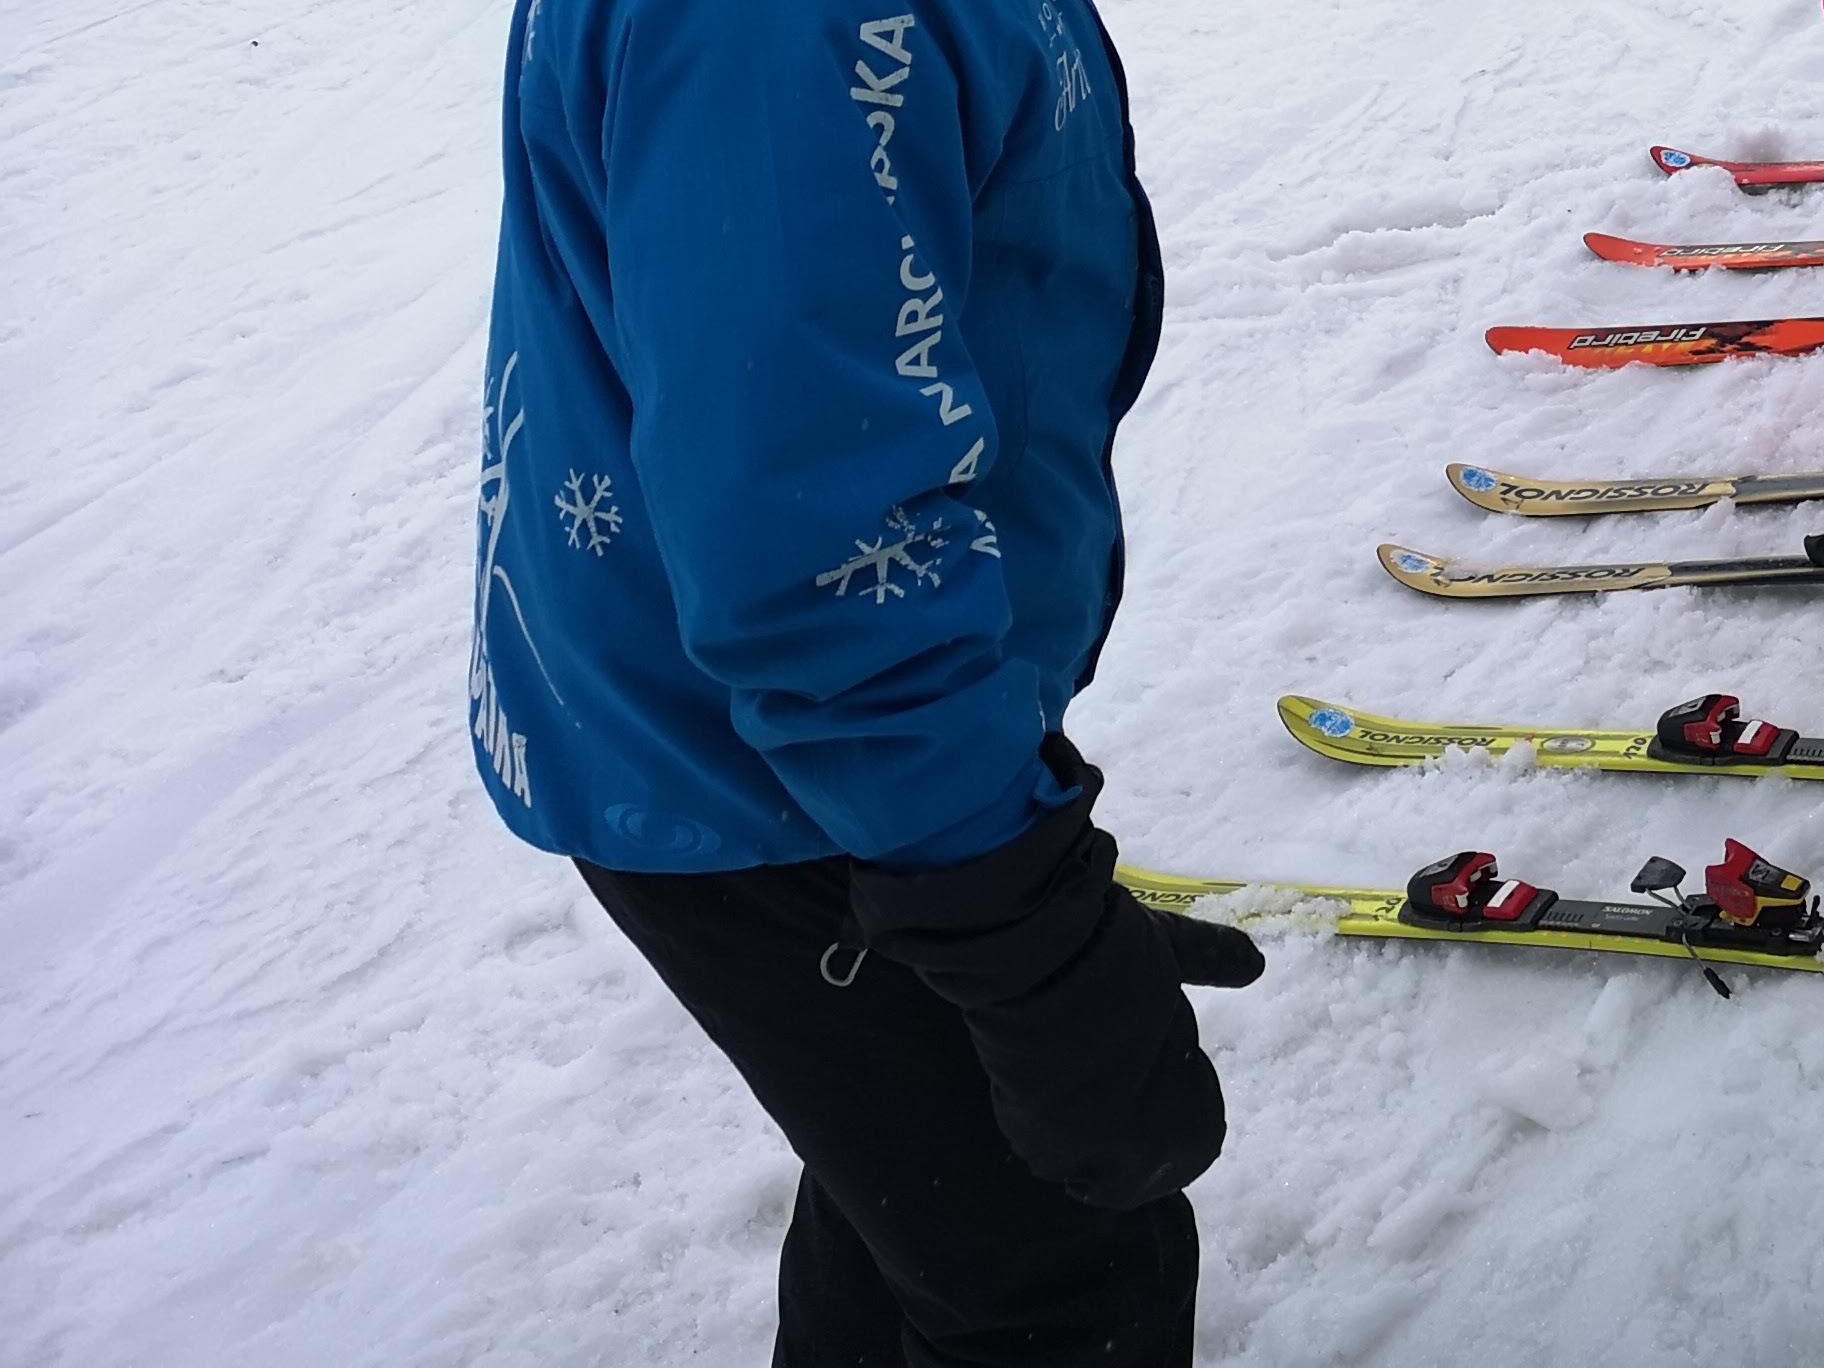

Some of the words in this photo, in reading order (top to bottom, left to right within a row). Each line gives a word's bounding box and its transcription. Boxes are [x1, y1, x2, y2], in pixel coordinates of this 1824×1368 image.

[1569, 327, 1707, 350] Firebird
[1500, 482, 1710, 501] ROSSIGNOL
[1359, 729, 1497, 747] ROSSIGNOL
[1601, 906, 1653, 916] SALOMON
